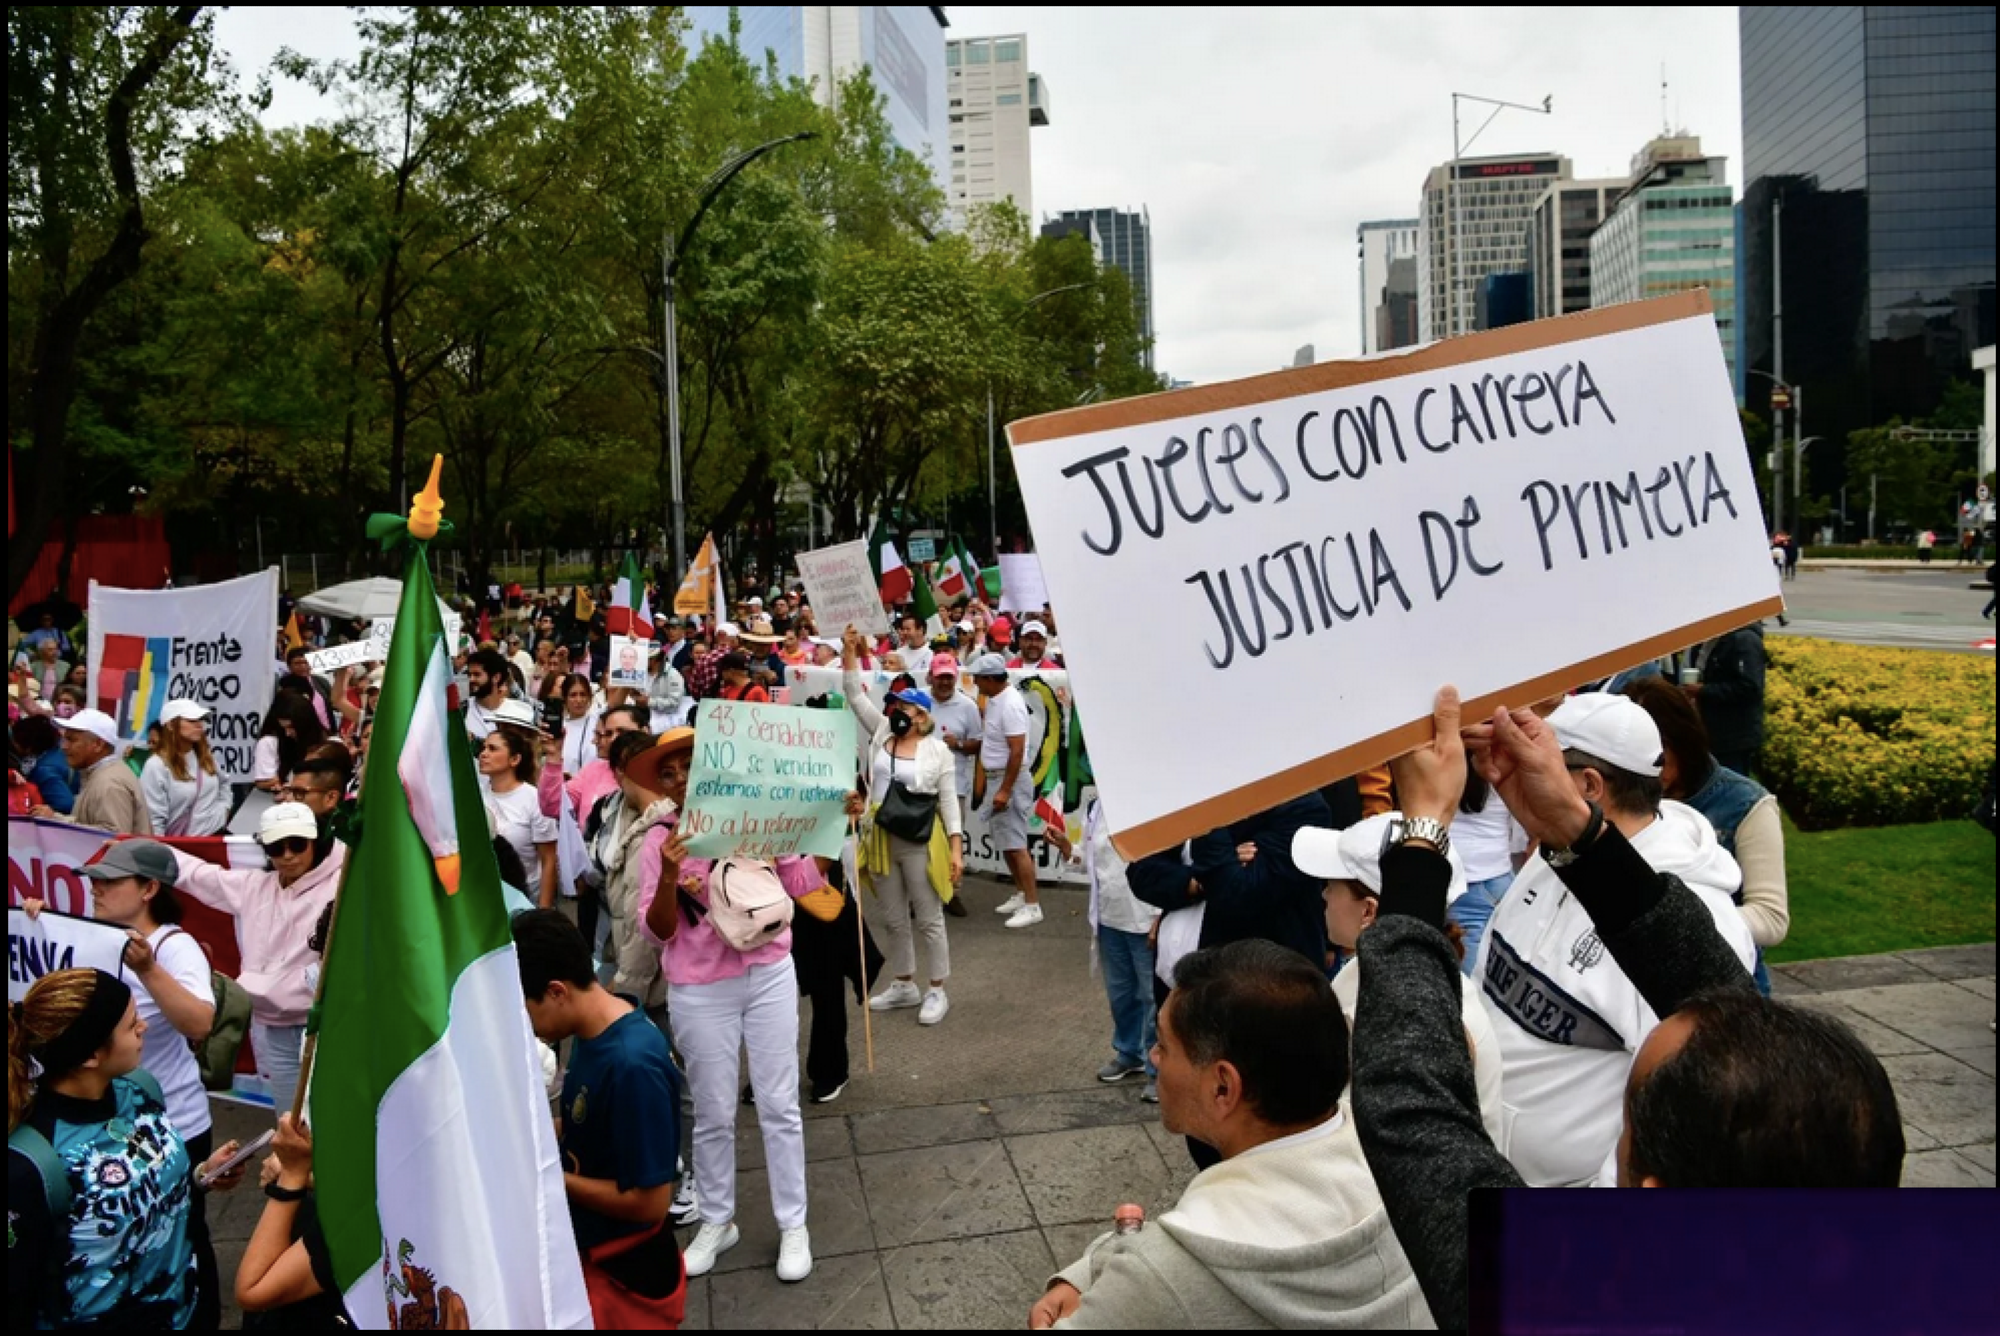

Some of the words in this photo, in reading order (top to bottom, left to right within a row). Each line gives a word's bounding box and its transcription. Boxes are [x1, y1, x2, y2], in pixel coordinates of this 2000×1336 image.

[1184, 526, 1412, 669] JUSTICIA
[172, 631, 242, 667] Frente
[703, 740, 736, 771] NO
[769, 784, 795, 801] con
[8, 856, 85, 918] NO
